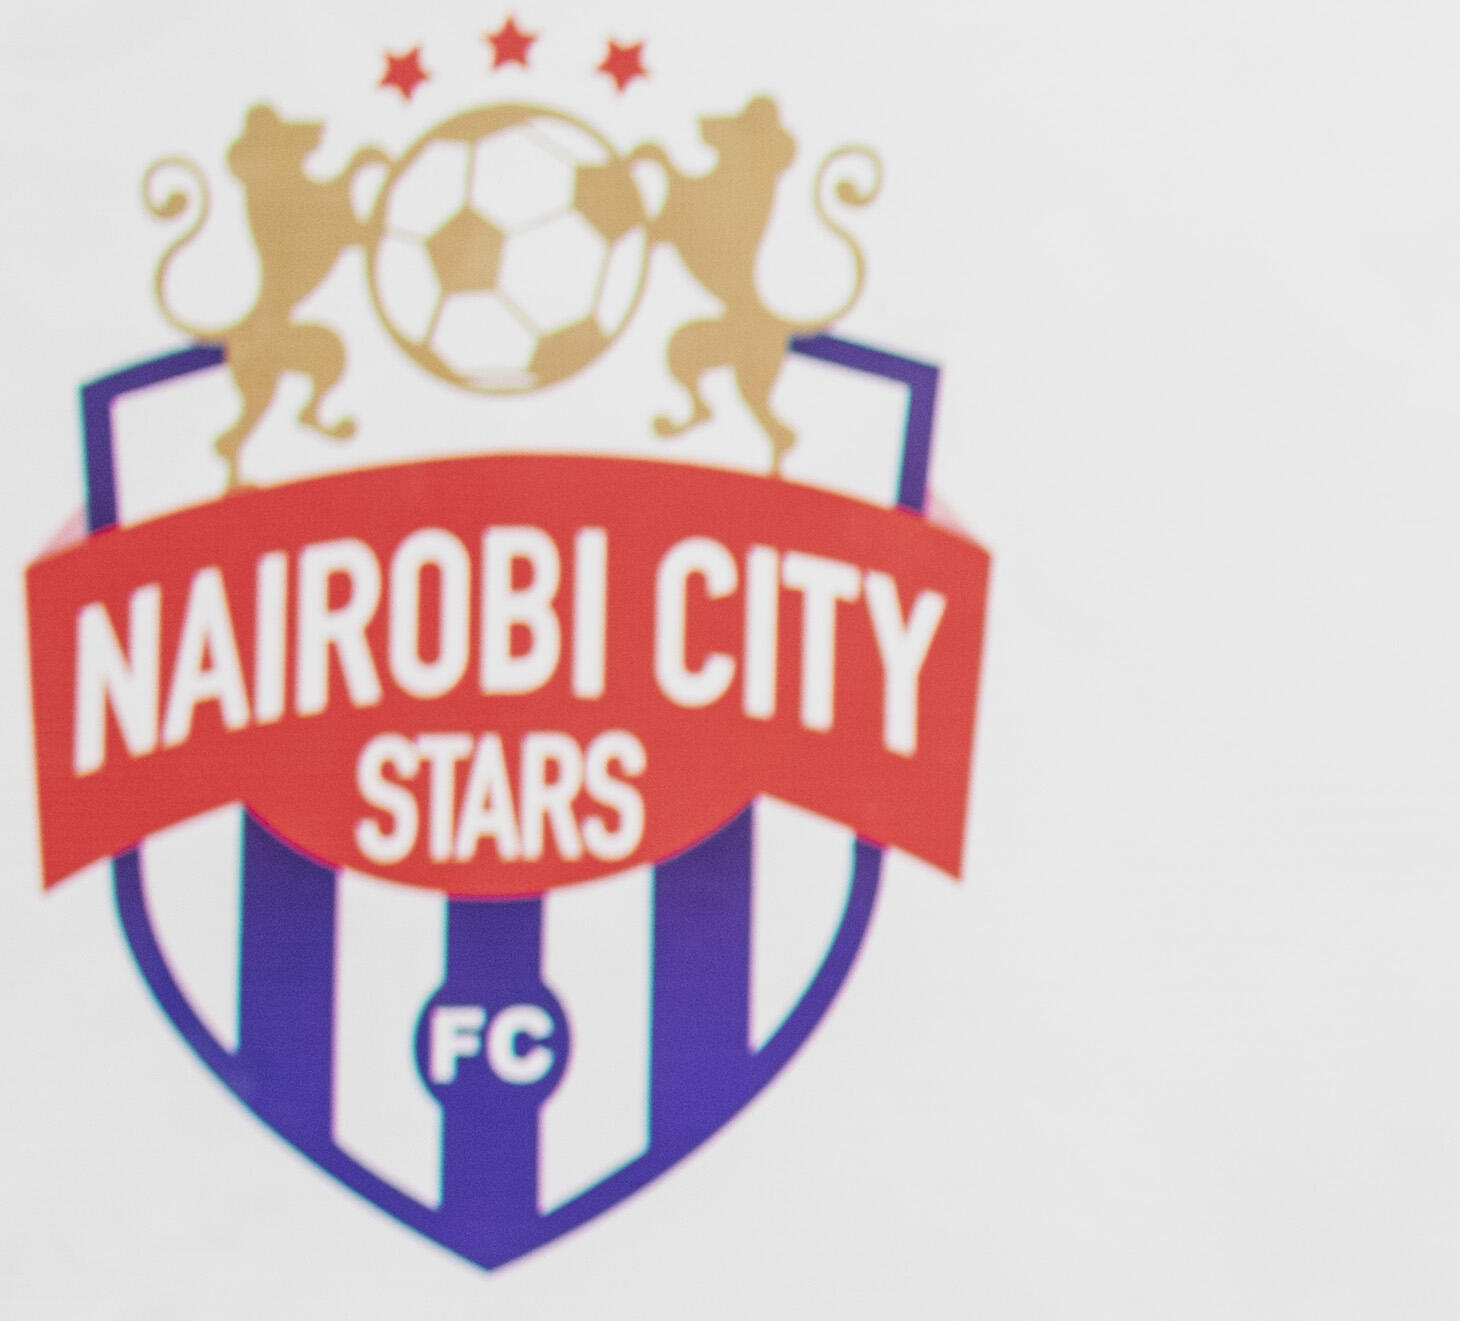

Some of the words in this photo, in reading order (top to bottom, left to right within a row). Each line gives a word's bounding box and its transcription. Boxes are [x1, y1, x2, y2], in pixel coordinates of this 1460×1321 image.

[74, 526, 608, 779] NAIROBI
[653, 536, 947, 759] CITY
[357, 731, 648, 864] STARS
[430, 1006, 555, 1084] FC
